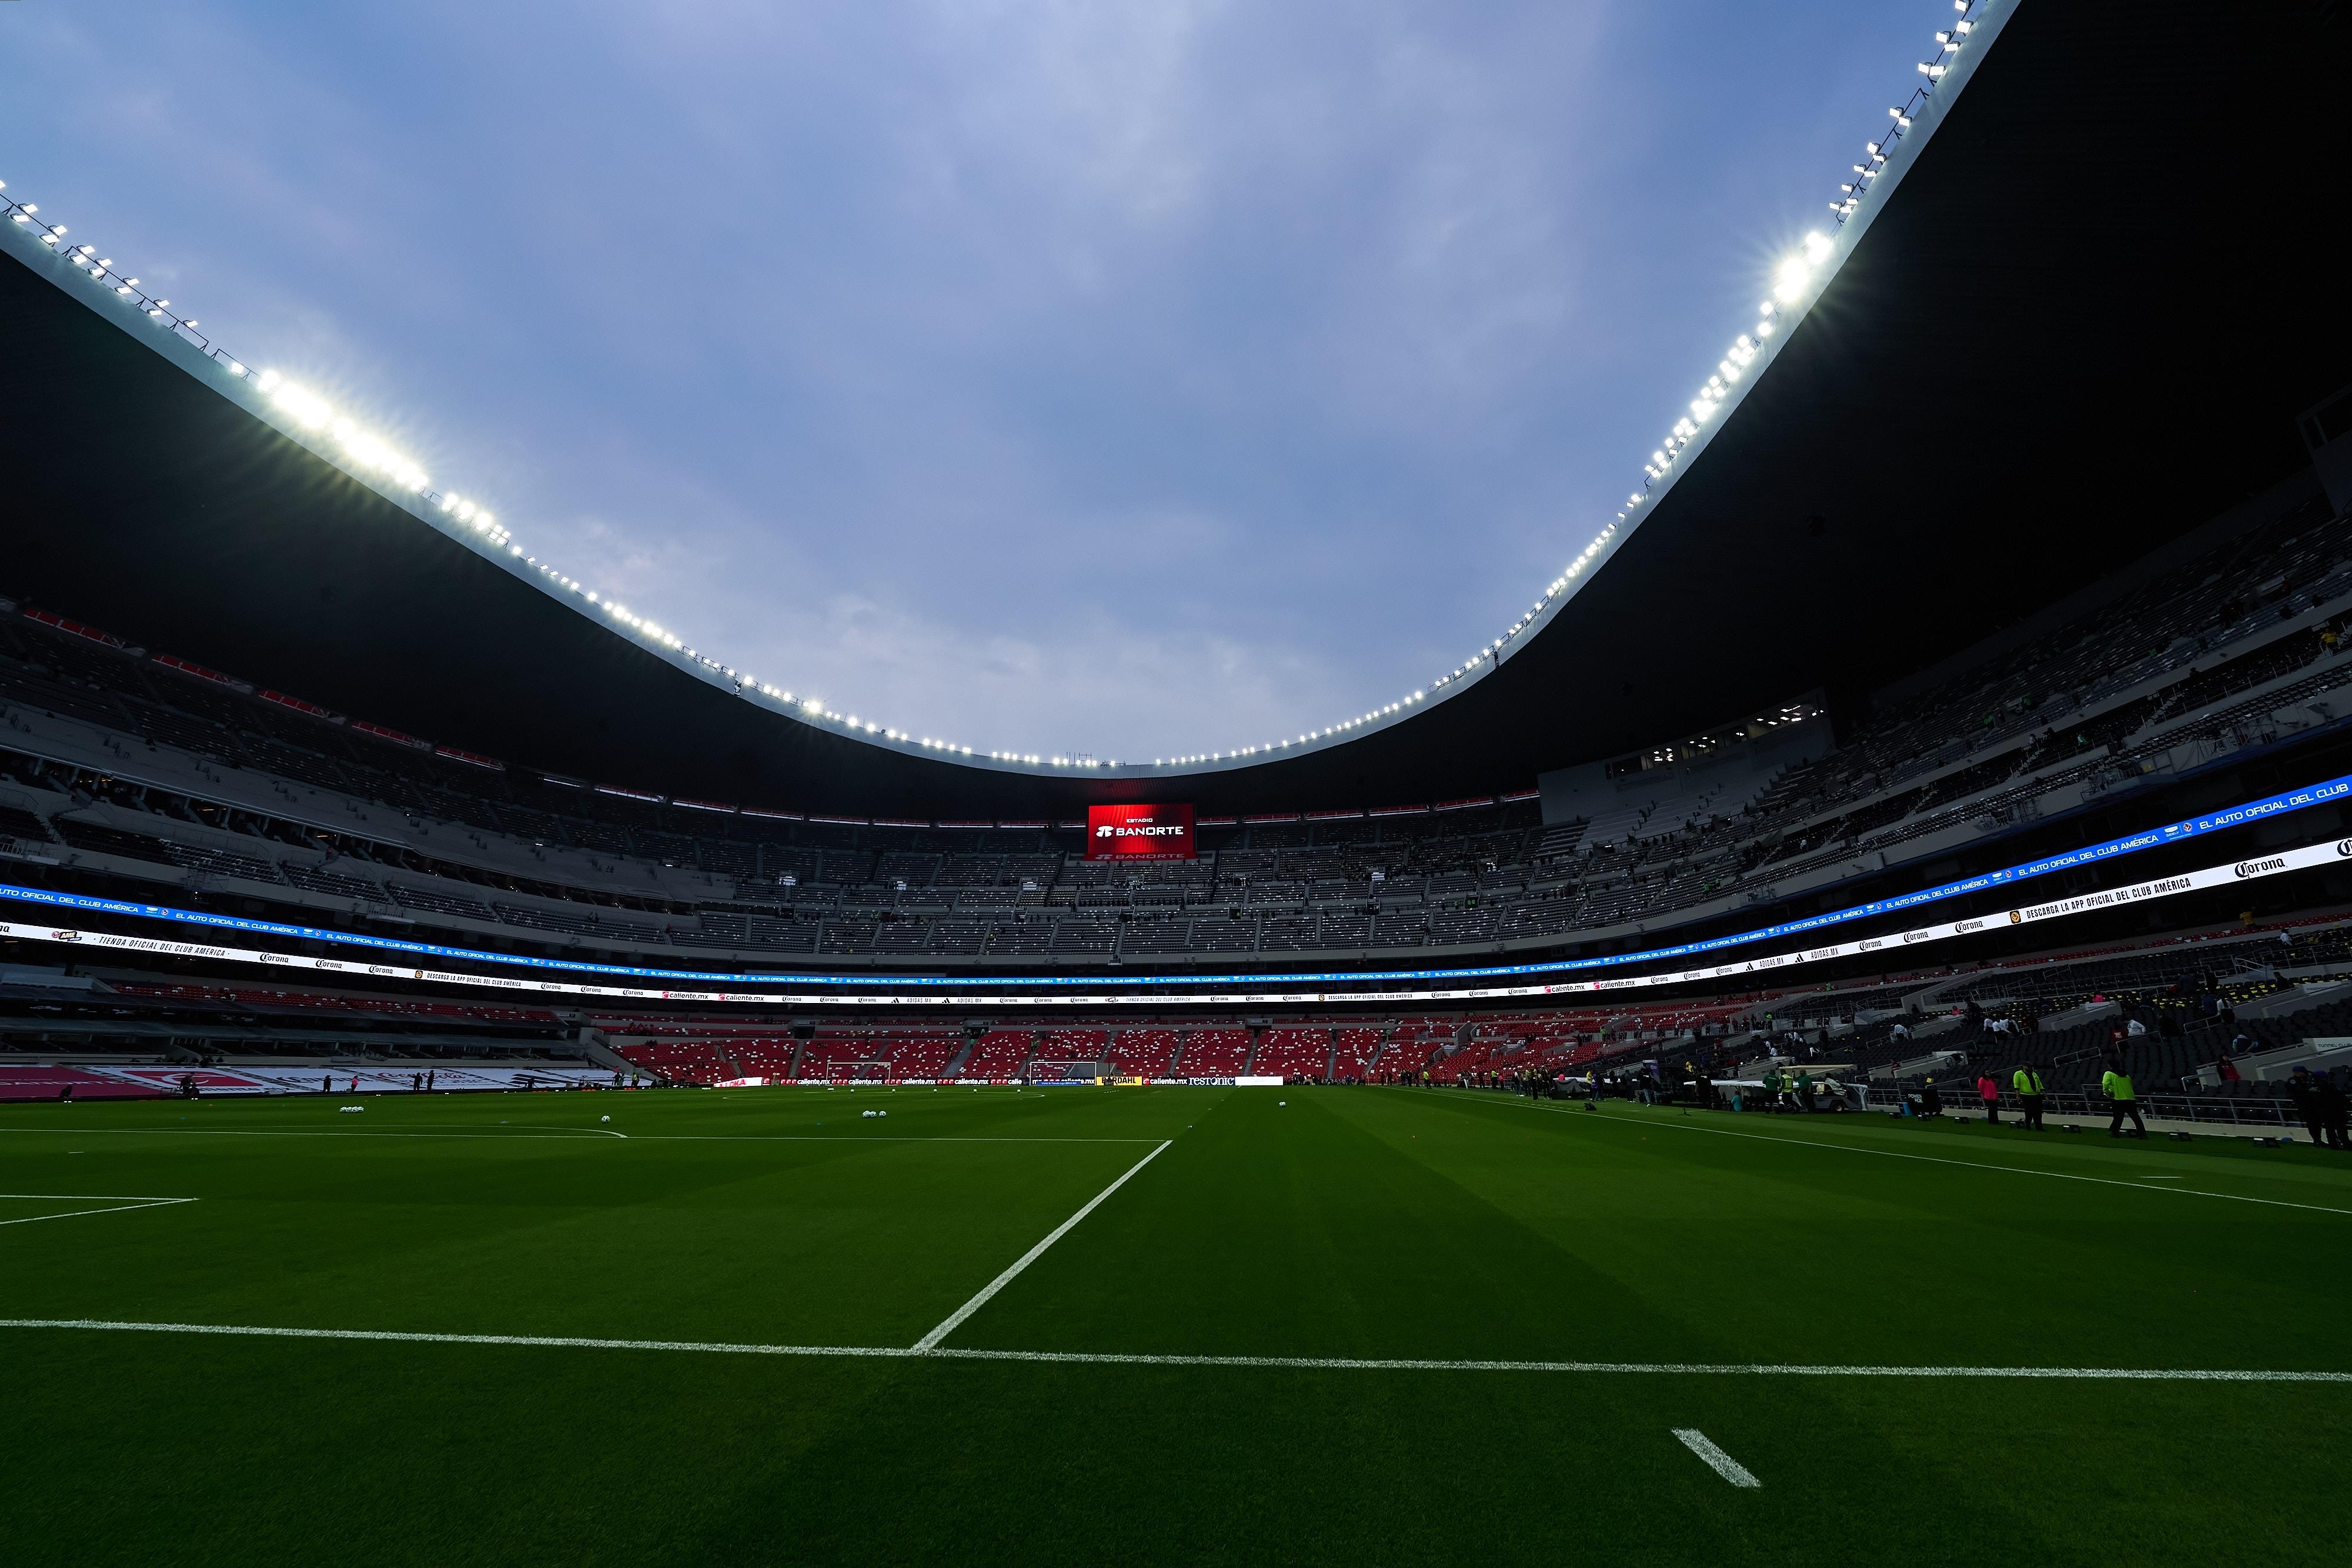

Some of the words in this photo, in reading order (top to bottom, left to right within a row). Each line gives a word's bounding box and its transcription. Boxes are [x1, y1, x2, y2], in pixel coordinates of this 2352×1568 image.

[2199, 820, 2213, 830] EL
[2215, 811, 2243, 825] AUTO
[2245, 800, 2288, 817] OFICIAL
[2288, 793, 2314, 805] DEL
[2316, 783, 2349, 798] CLUB
[1116, 826, 1184, 836] BANORTE
[2029, 862, 2049, 874] AUTO
[2050, 855, 2079, 868] OFICIAL
[2079, 851, 2096, 861] DEL
[2097, 845, 2119, 856] CLUB
[2120, 835, 2159, 850] AMÉRICA
[2234, 858, 2288, 878] Corona
[1895, 898, 1910, 907] AUTO
[1910, 893, 1932, 903] OFICIAL
[1944, 885, 1960, 895] CLUB
[1961, 878, 1989, 891] AMÉRICA
[2026, 904, 2059, 919] DESCARGA
[2060, 902, 2070, 912] LA
[2071, 899, 2084, 910] APP
[2086, 893, 2114, 907] OFICIAL
[2115, 890, 2130, 901] DEL
[2132, 885, 2151, 898] CLUB
[2153, 877, 2191, 894] AMÉRICA
[0, 888, 19, 896] UTO
[21, 891, 56, 901] OFICIAL
[58, 896, 76, 904] DEL
[78, 899, 101, 907] CLUB
[102, 902, 138, 912] AMÉRICA
[1842, 909, 1864, 918] AMÉRICA
[208, 917, 235, 926] OFICIAL
[269, 926, 298, 934] AMÉRICA
[1955, 920, 1984, 934] Corona
[1903, 931, 1929, 943] Corona
[98, 936, 126, 946] TIENDA
[128, 940, 158, 950] OFICIAL
[174, 945, 193, 953] CLUB
[193, 947, 225, 957] AMÉRICA
[1859, 940, 1882, 951] Corona
[259, 953, 289, 963] Corona
[1810, 947, 1839, 959] ADIDAS.MX
[315, 959, 342, 969] Corona
[1759, 957, 1784, 968] ADIDAS.MX
[368, 965, 393, 974] Corona
[1716, 967, 1732, 975] Corona
[1600, 980, 1635, 988] caliente.mx
